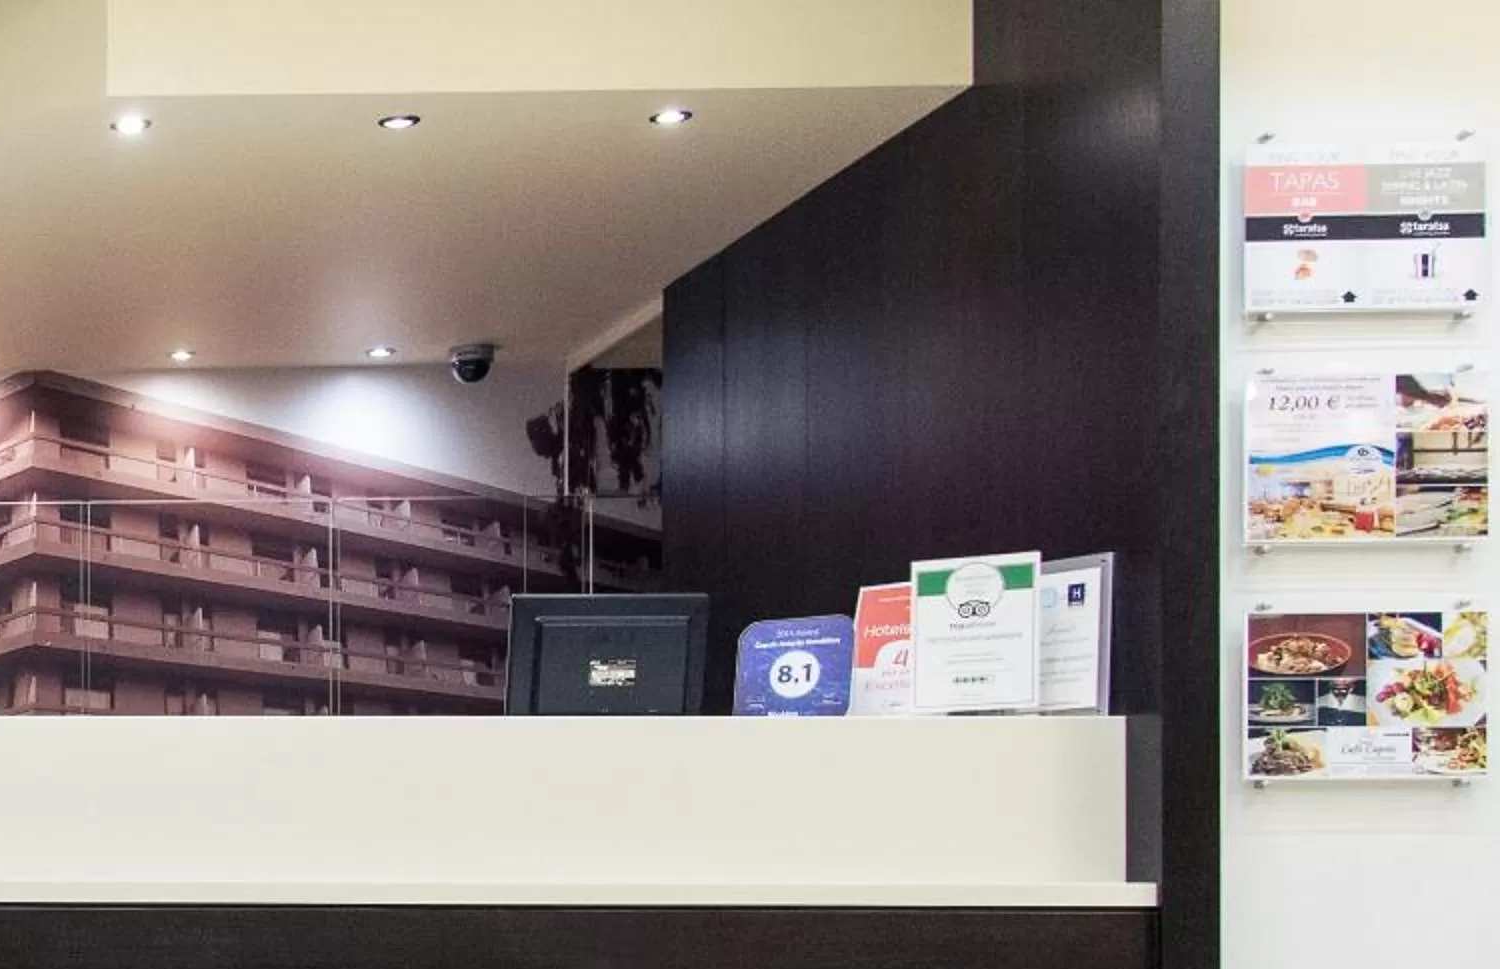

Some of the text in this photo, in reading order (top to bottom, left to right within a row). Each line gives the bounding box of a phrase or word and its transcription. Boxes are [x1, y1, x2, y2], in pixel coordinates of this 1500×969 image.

[1269, 172, 1340, 192] TAPAS
[1268, 394, 1319, 412] 12,00
[777, 663, 812, 683] 8.1
